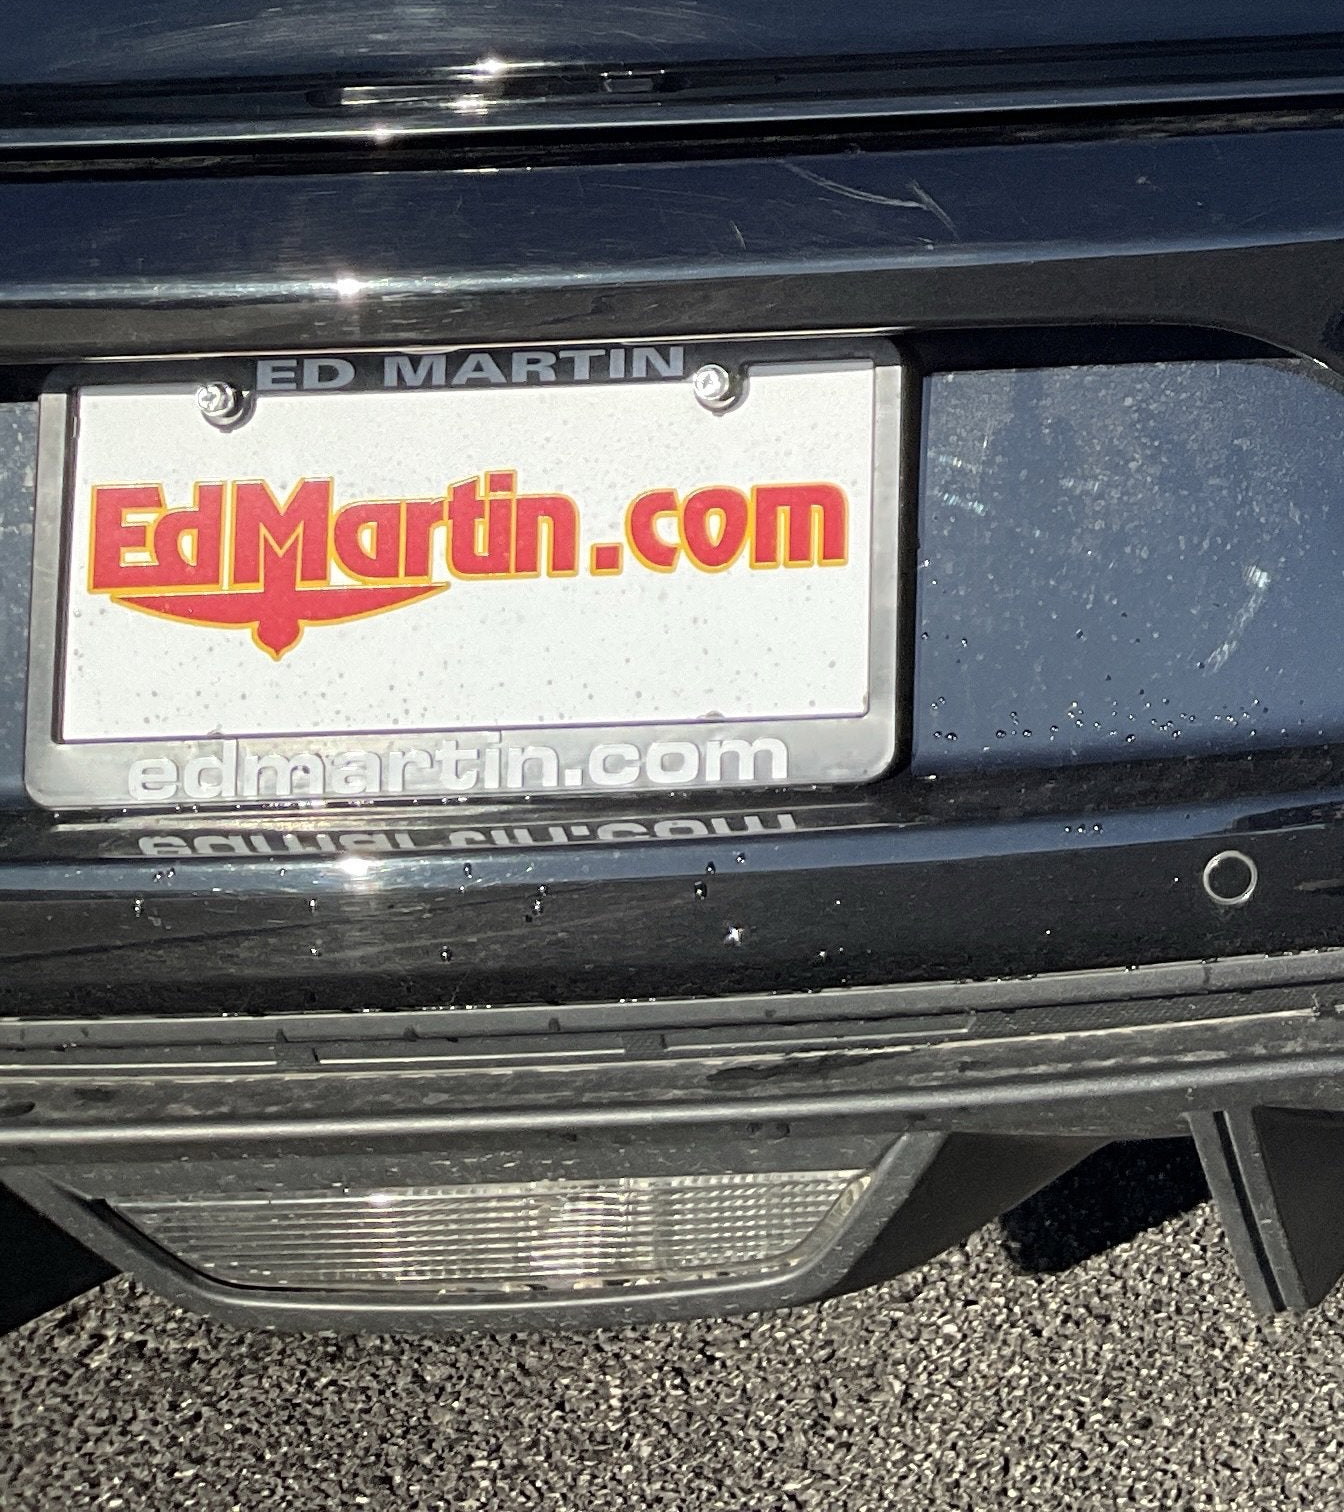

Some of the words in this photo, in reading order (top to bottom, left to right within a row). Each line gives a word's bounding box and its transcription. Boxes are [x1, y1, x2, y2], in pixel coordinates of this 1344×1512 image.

[256, 355, 357, 392] ED
[383, 345, 687, 390] MARTIN
[87, 468, 850, 595] EdMartin.com
[127, 733, 790, 803] edmartin.com
